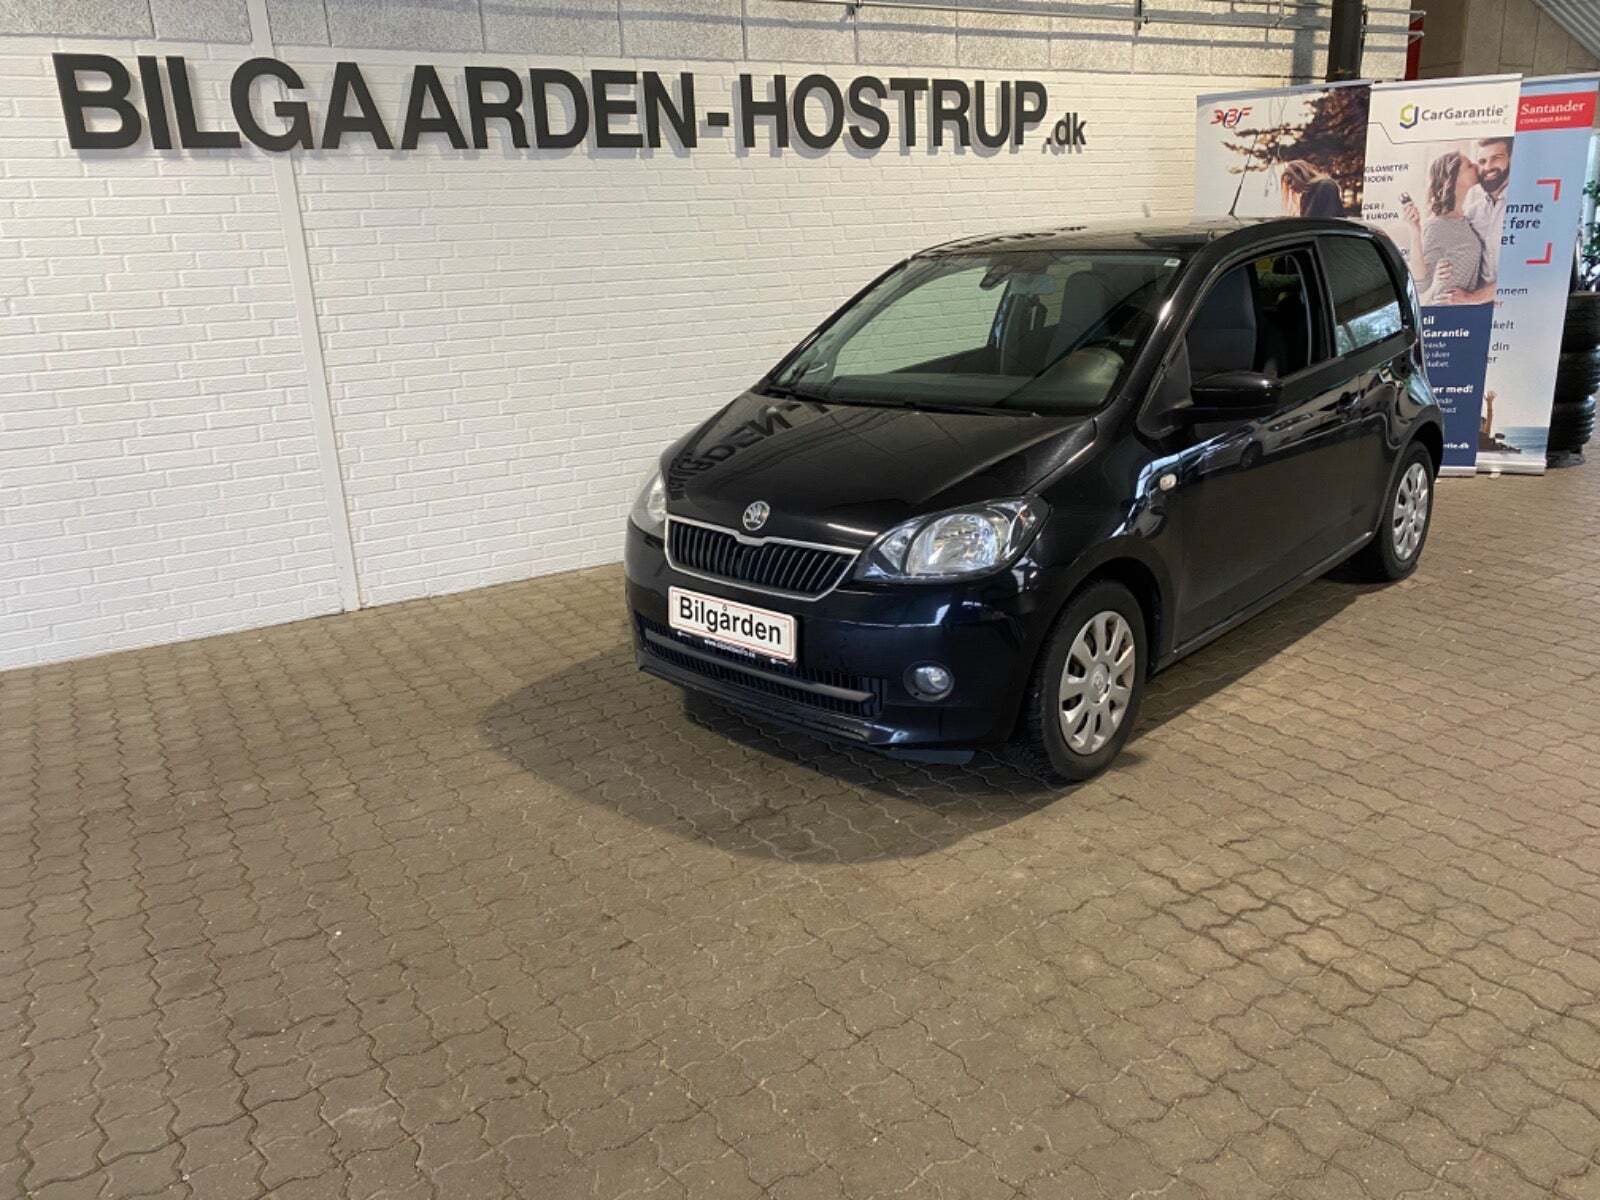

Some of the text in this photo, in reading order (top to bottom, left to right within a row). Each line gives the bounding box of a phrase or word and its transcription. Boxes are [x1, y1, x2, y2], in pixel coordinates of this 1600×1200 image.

[1421, 105, 1504, 121] CarGarantie
[1520, 99, 1586, 116] Santander
[1510, 216, 1541, 229] føre
[680, 596, 782, 645] Bilgården
